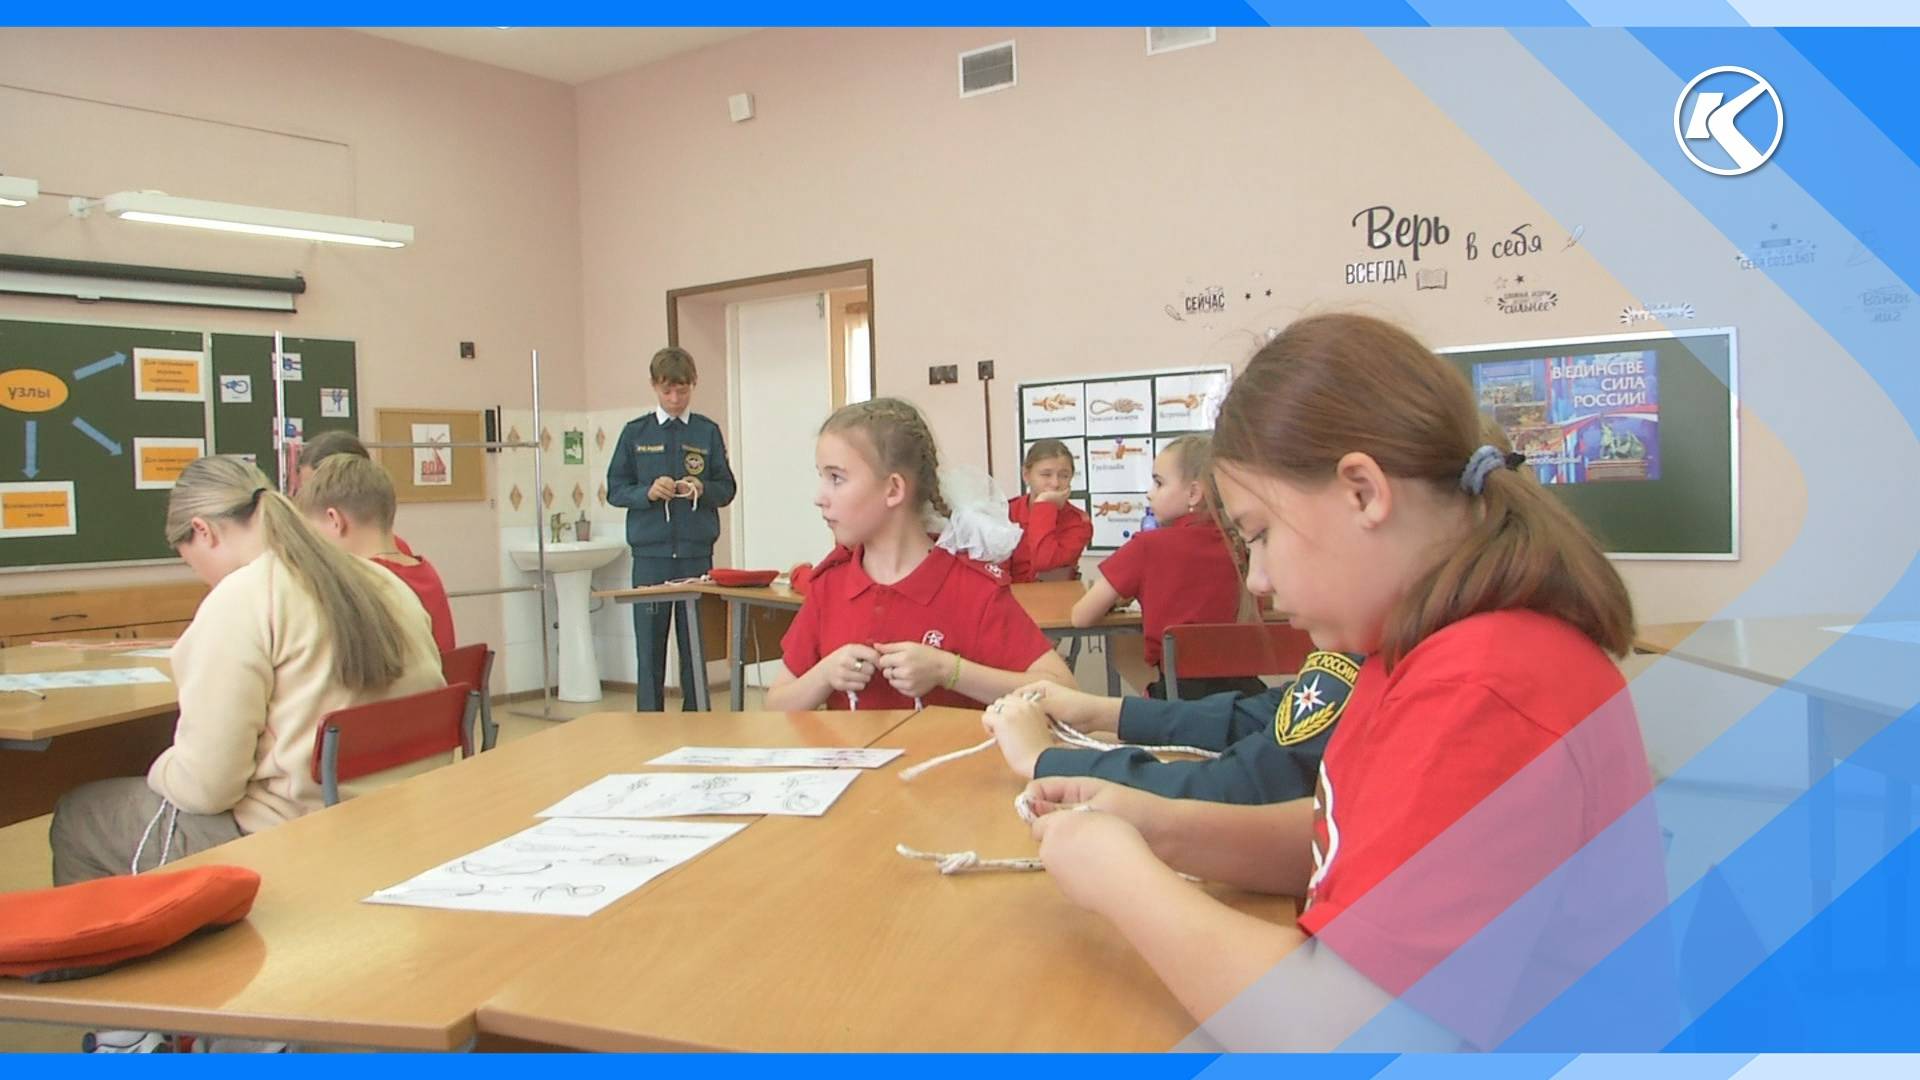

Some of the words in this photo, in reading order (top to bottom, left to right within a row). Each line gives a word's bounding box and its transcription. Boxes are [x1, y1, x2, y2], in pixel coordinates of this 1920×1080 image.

[1352, 206, 1450, 261] Верь
[1466, 232, 1478, 260] в
[1492, 224, 1543, 259] себя
[1346, 259, 1407, 285] ВСЕГДА
[1185, 292, 1225, 312] СЕЙЧАС
[1552, 366, 1561, 379] В
[1566, 360, 1646, 378] ЕДИНСТВЕ
[8, 386, 50, 400] узлы
[1601, 376, 1647, 391] СИЛА
[1574, 392, 1647, 408] РОССИИ!
